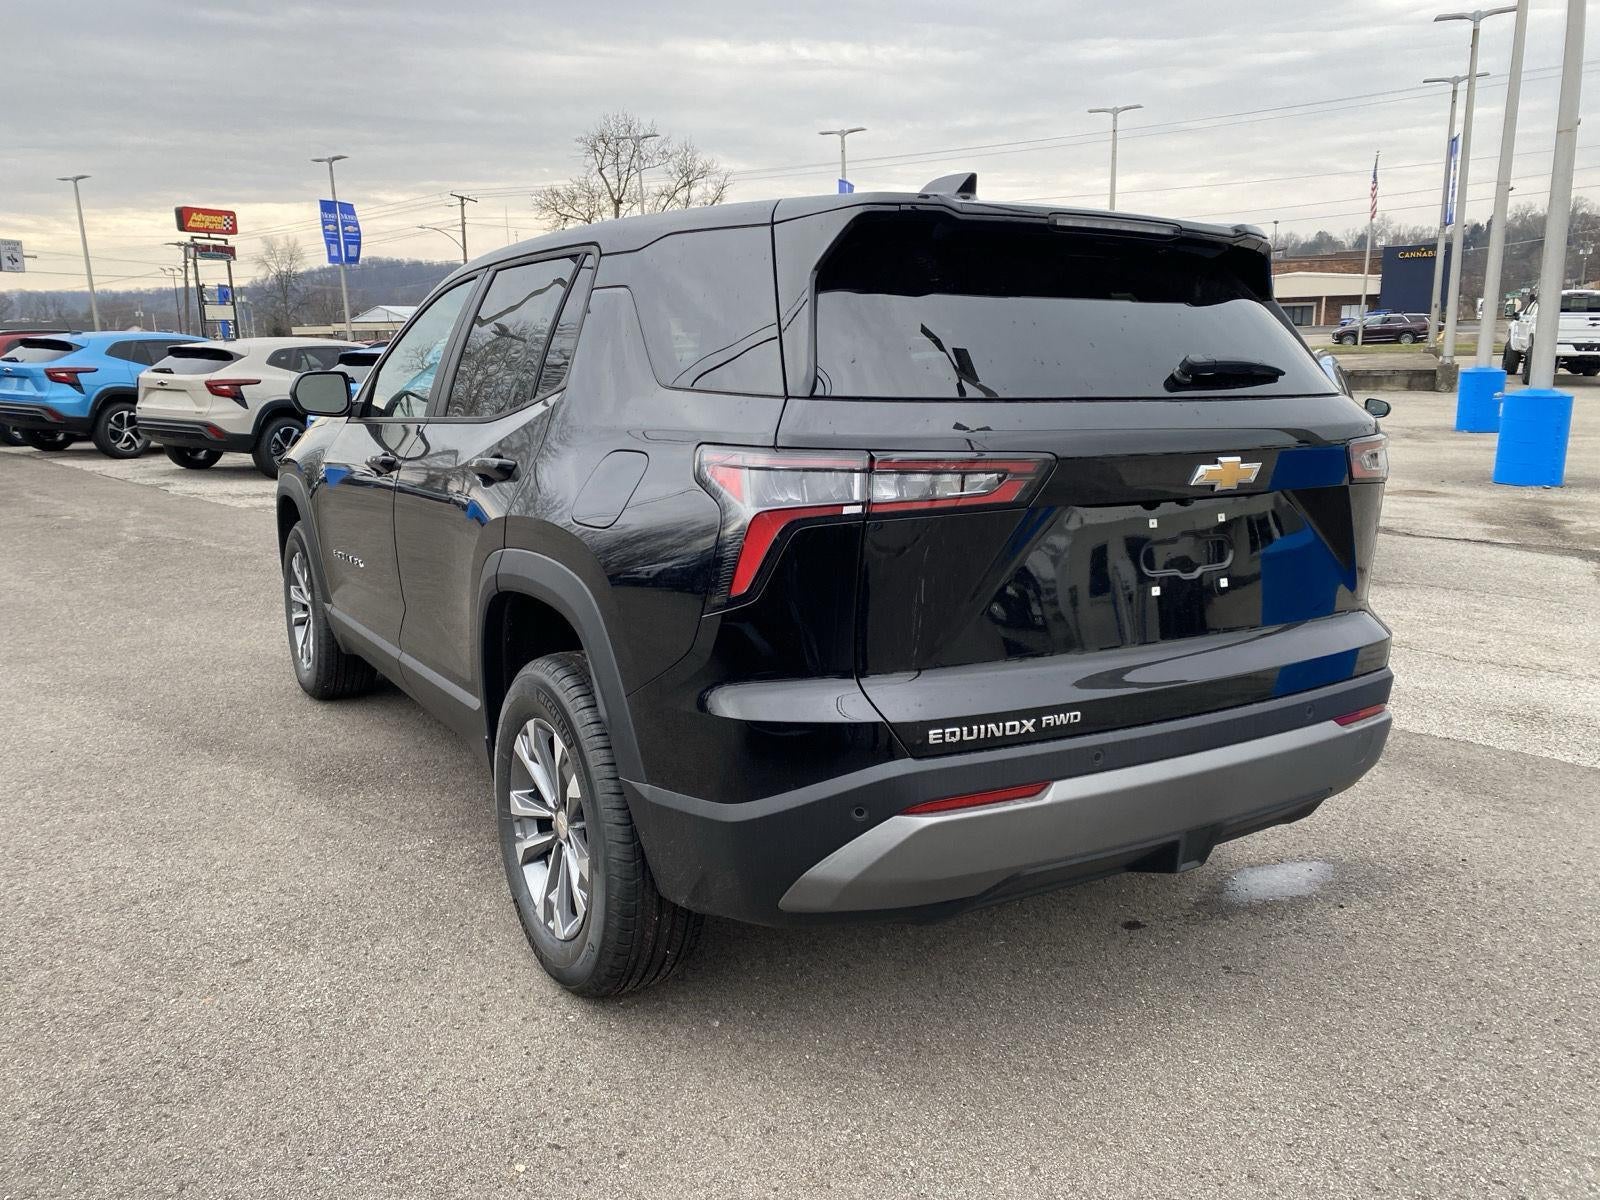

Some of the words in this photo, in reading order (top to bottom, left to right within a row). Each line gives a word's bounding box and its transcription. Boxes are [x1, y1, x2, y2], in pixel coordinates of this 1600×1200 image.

[191, 212, 222, 223] Advance
[187, 220, 204, 228] Auto
[204, 222, 222, 230] Parts
[1398, 250, 1448, 259] CANNABI
[928, 718, 1037, 745] EQUINOX
[1041, 711, 1082, 728] AWD
